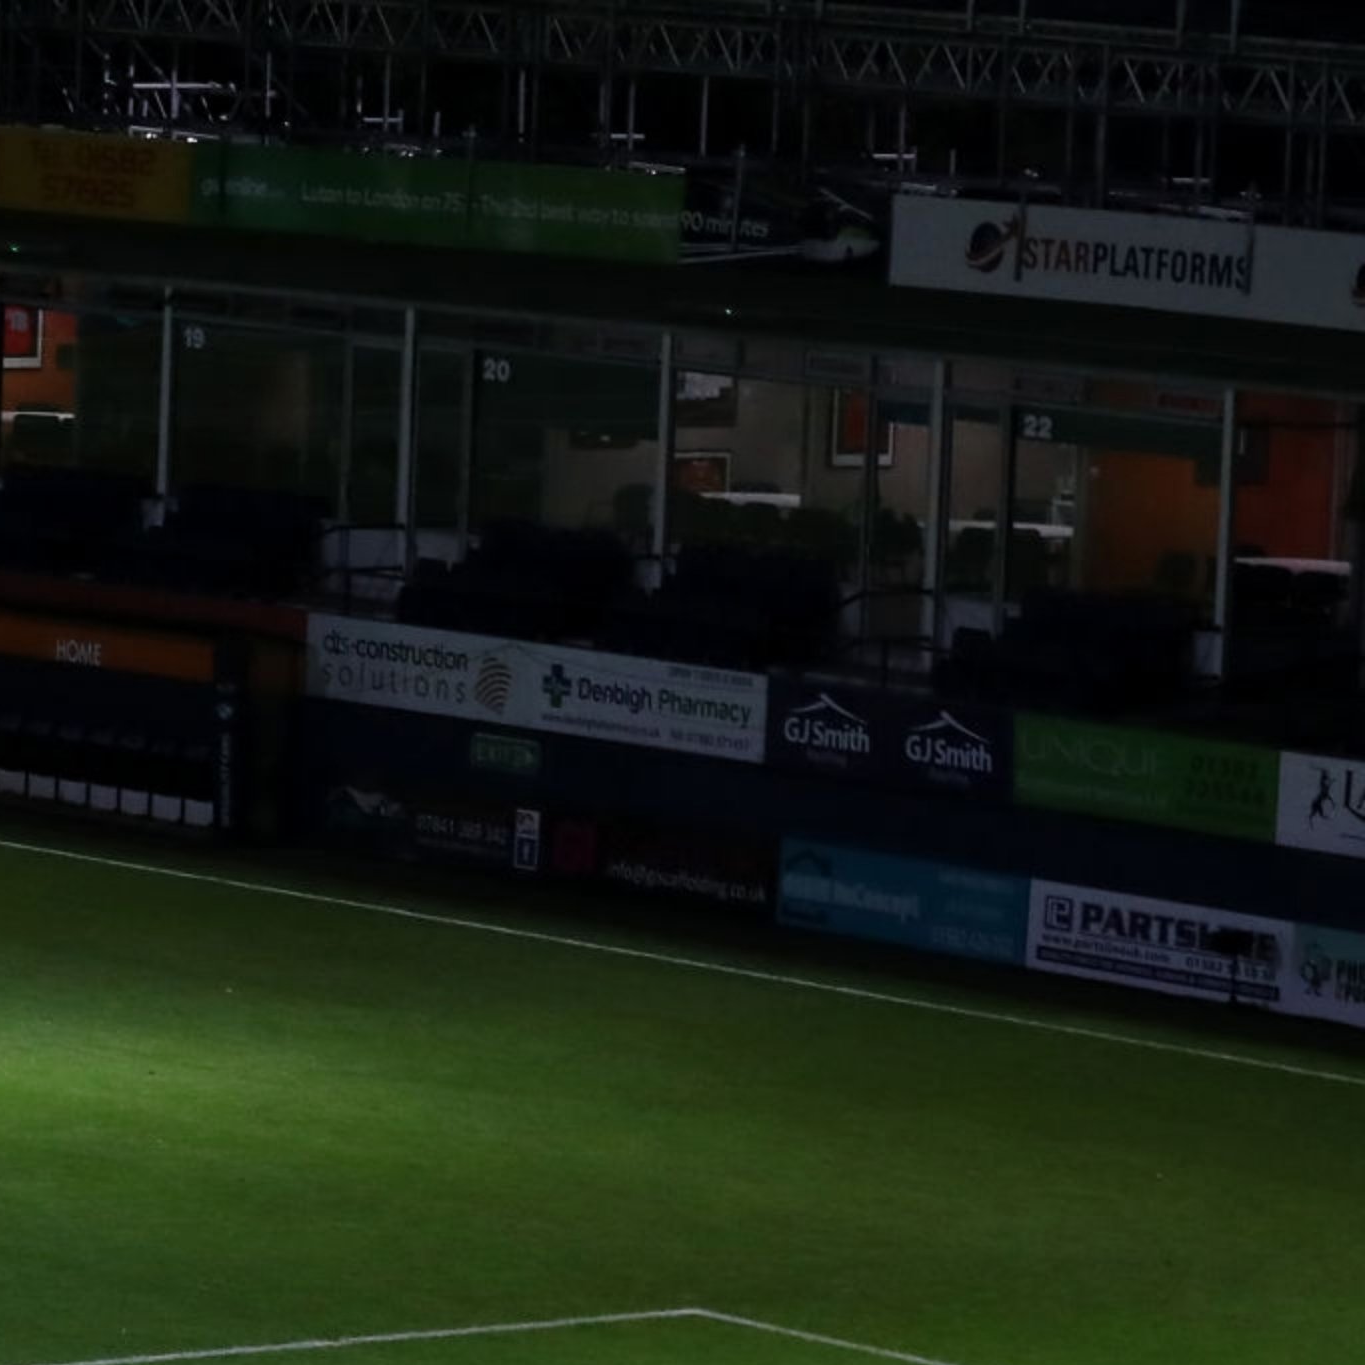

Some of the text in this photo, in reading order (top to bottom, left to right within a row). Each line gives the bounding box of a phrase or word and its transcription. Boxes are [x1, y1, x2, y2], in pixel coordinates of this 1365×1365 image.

[183, 327, 206, 349] 19
[483, 357, 511, 382] 20
[1023, 414, 1054, 440] 22
[54, 639, 102, 668] HOME
[322, 661, 467, 704] solutions
[578, 677, 652, 714] Denbigh
[658, 689, 752, 729] Pharmacy
